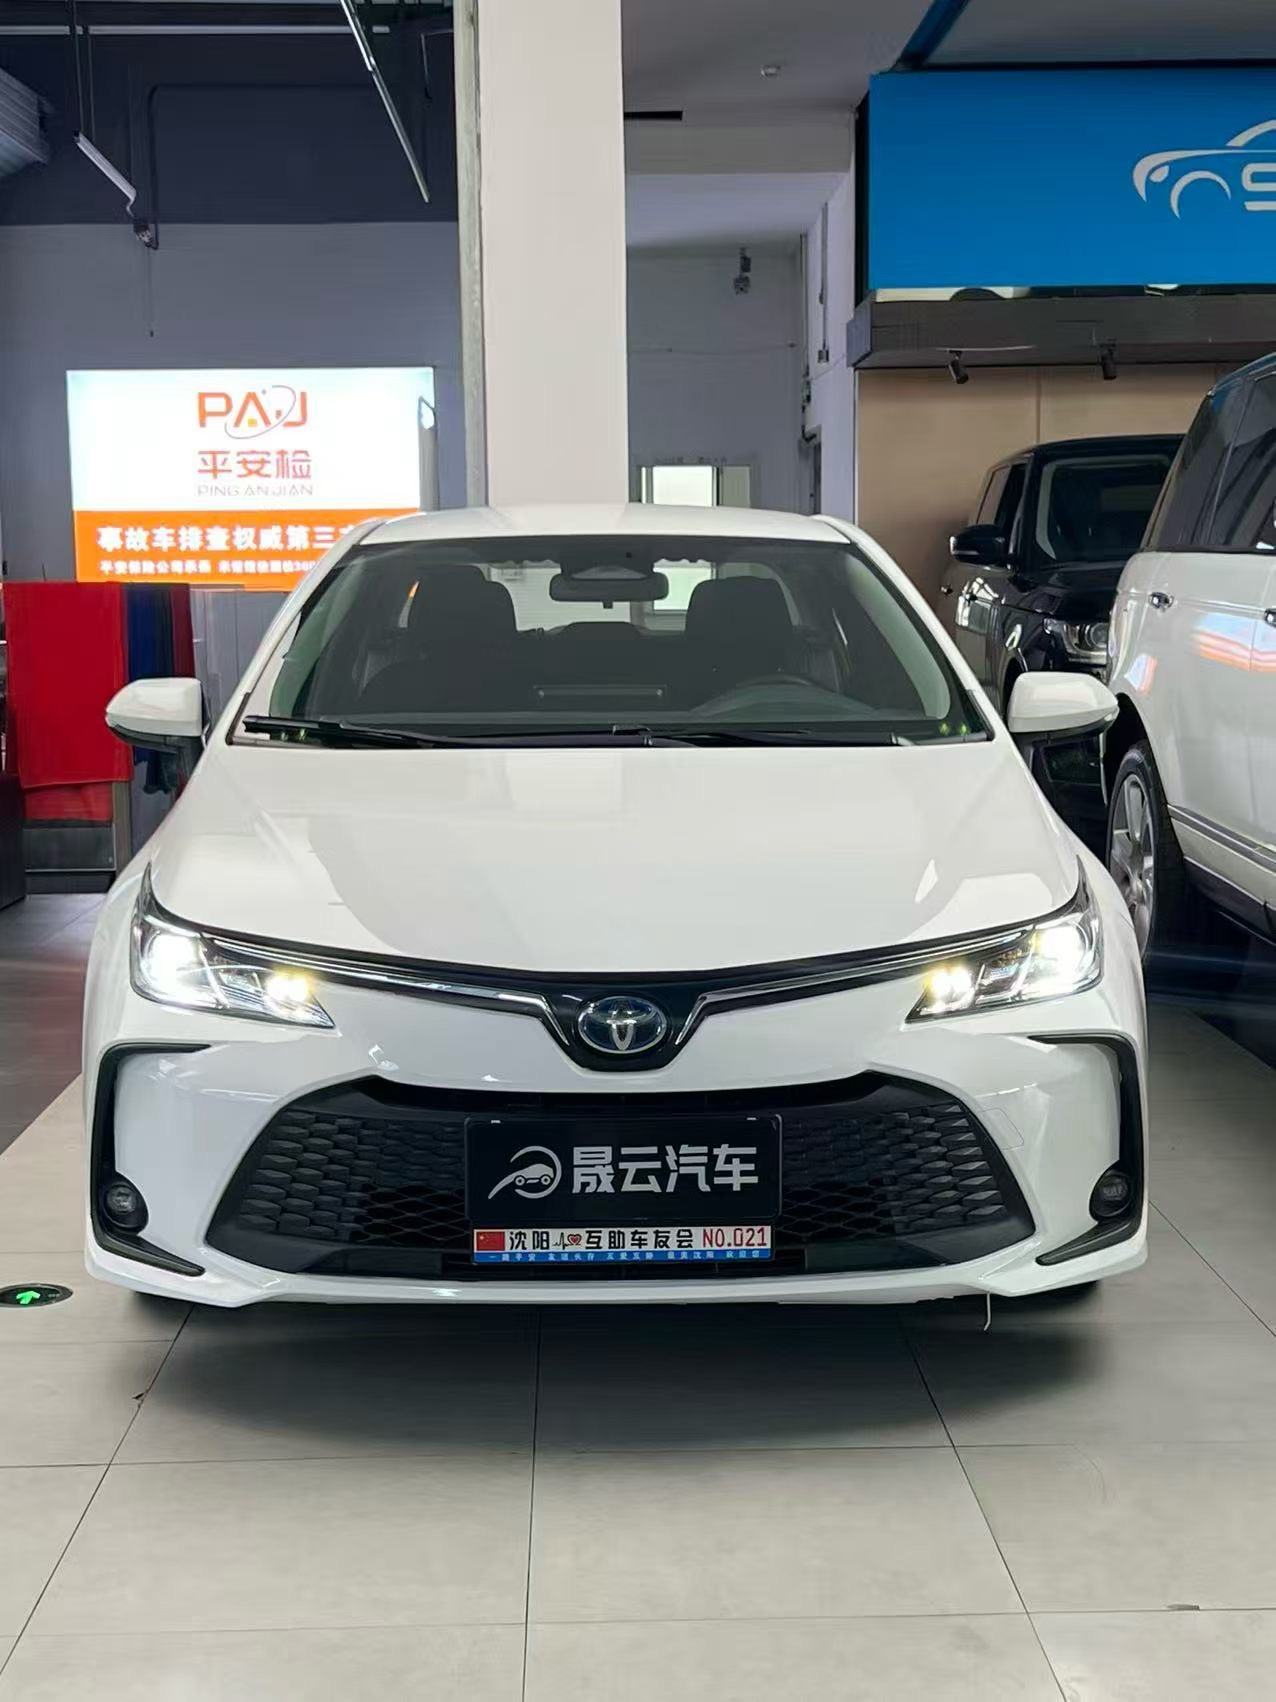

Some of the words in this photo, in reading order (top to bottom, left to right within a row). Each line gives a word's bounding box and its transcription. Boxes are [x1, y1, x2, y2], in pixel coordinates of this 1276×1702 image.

[197, 450, 312, 479] 平安检
[197, 484, 240, 497] PING
[572, 1144, 759, 1194] 晟云汽车
[509, 1230, 550, 1250] 沈阳
[585, 1228, 694, 1250] 互助车友会
[702, 1227, 767, 1247] NO.021
